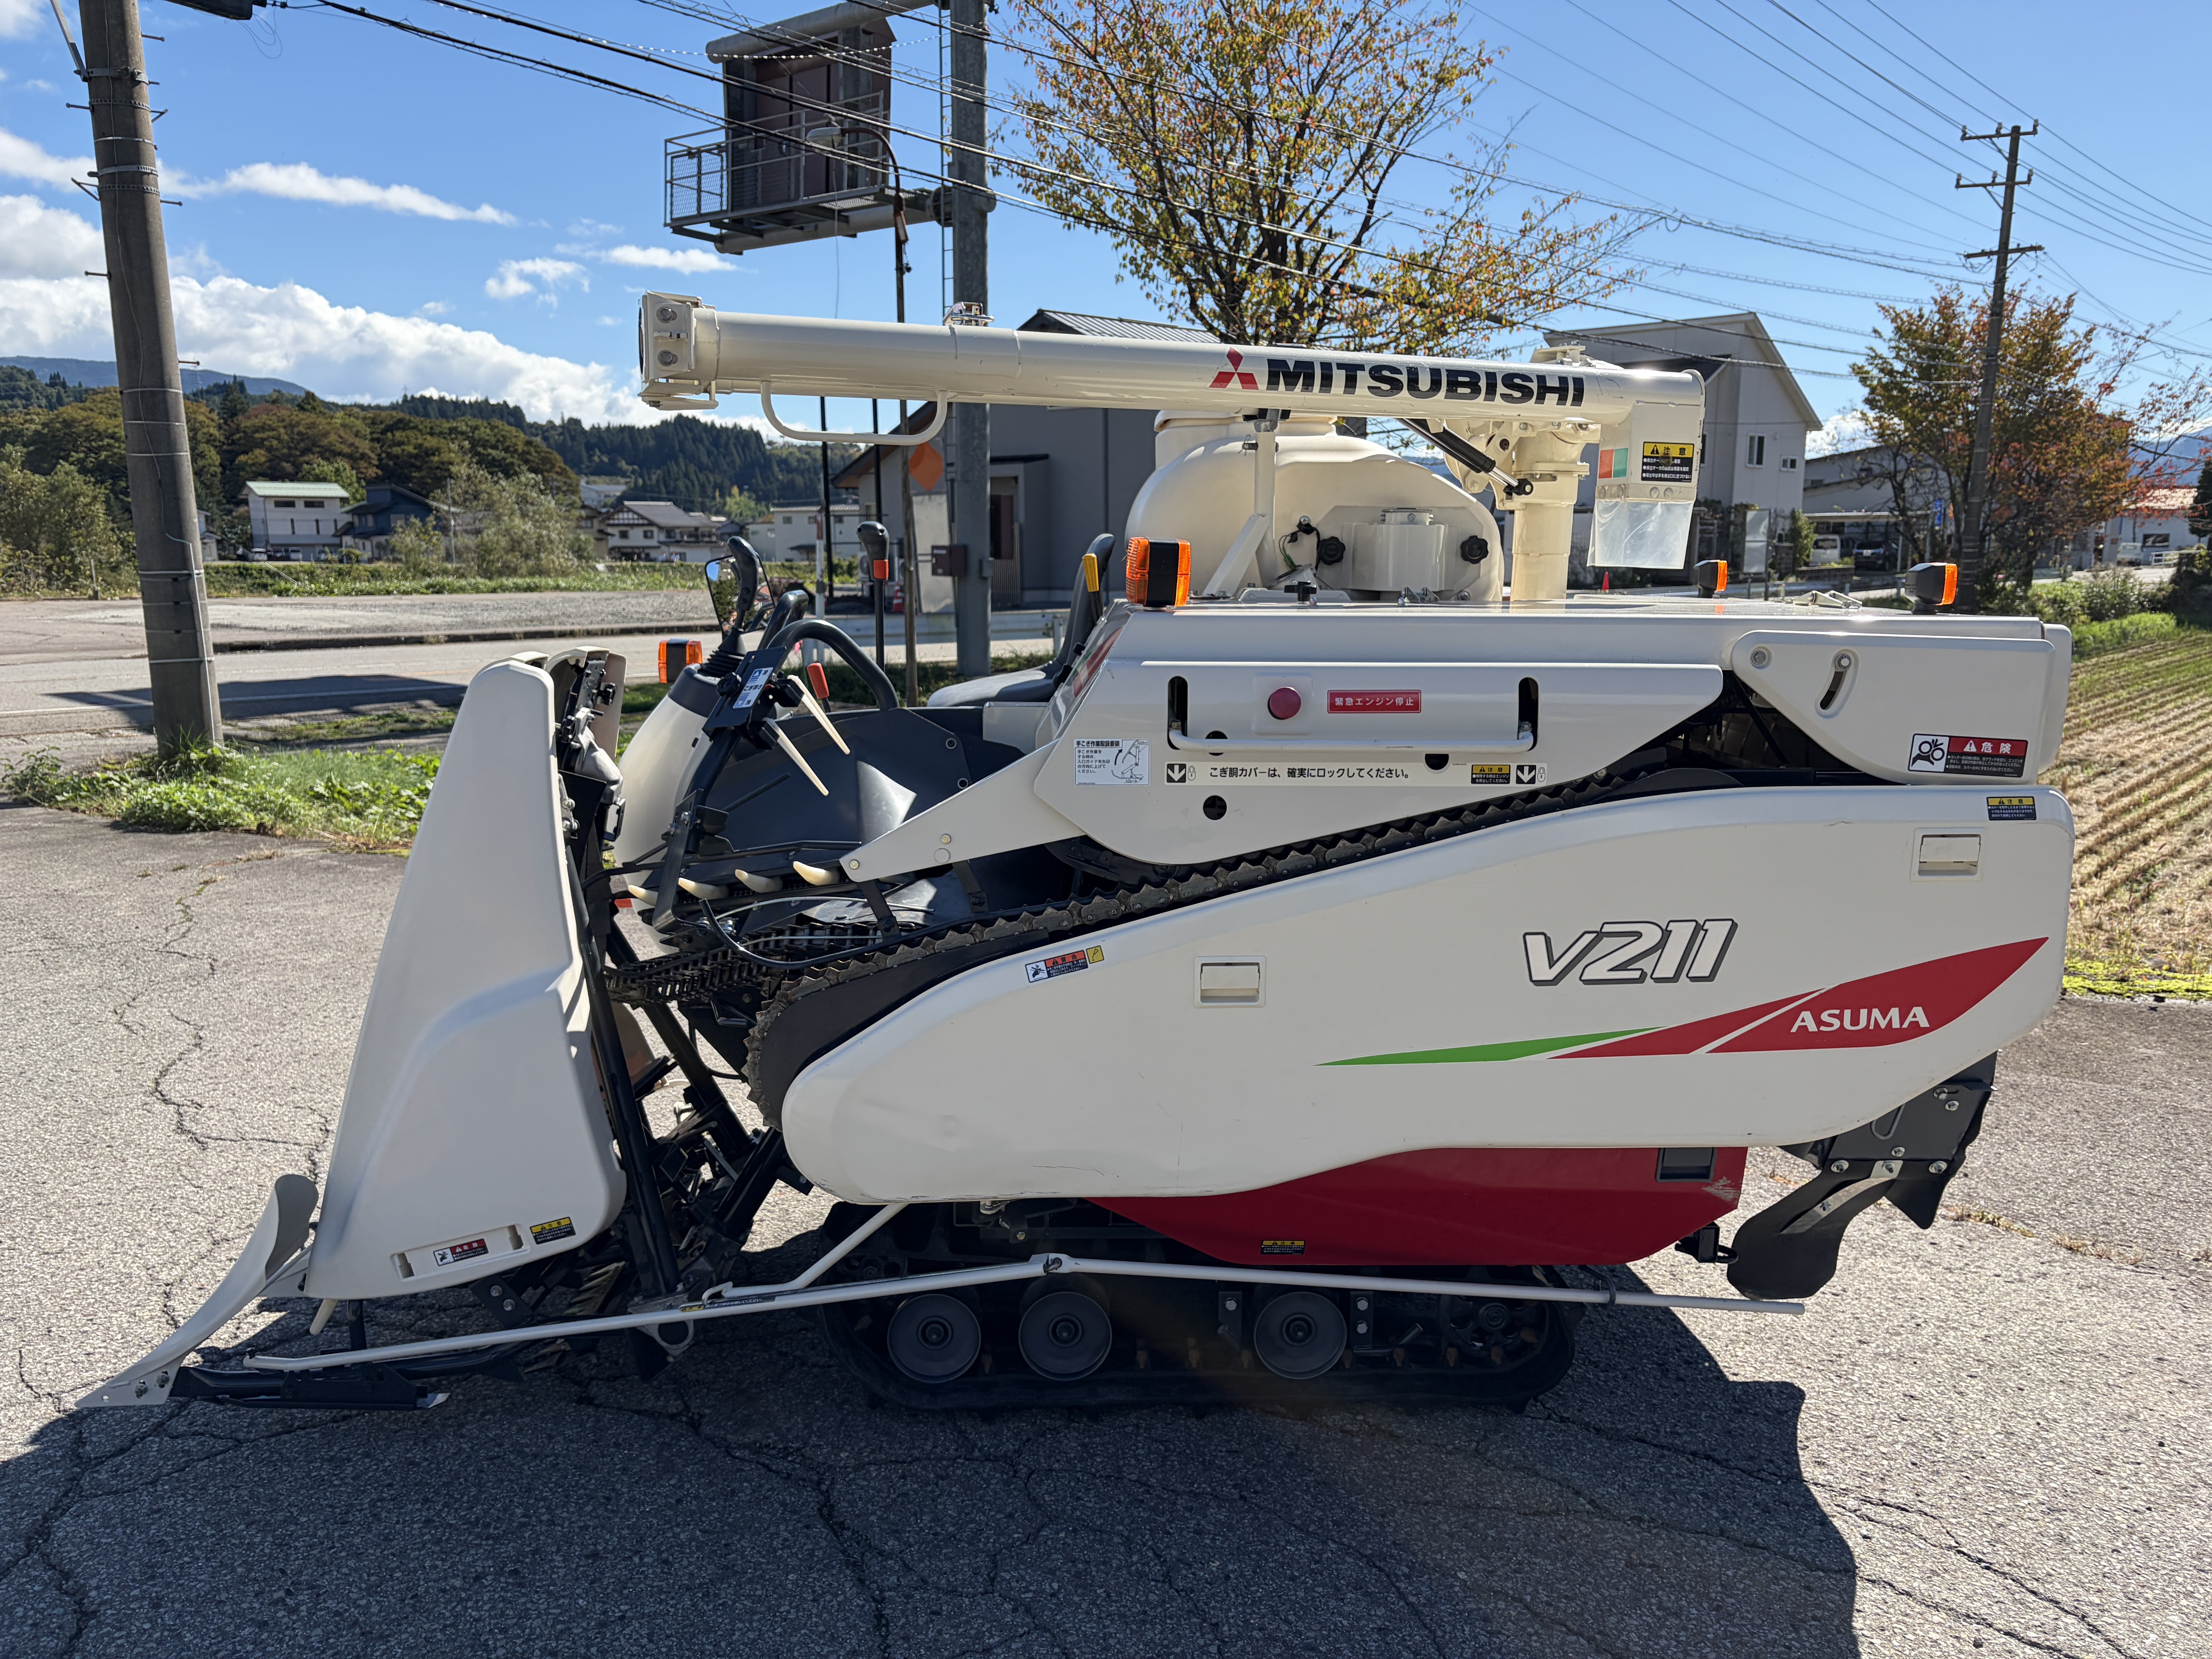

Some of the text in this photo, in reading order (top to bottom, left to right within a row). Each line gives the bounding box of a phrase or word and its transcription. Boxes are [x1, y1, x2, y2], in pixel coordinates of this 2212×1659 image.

[1266, 358, 1584, 407] MITSUBISHI
[1335, 697, 1414, 706] 緊急エンジン停止
[1981, 742, 2011, 754] 危険
[1209, 767, 1409, 779] こぎ胴カバーは、確実にロックしてください。
[1522, 918, 1738, 986] V211
[1790, 1006, 1930, 1033] ASUMA
